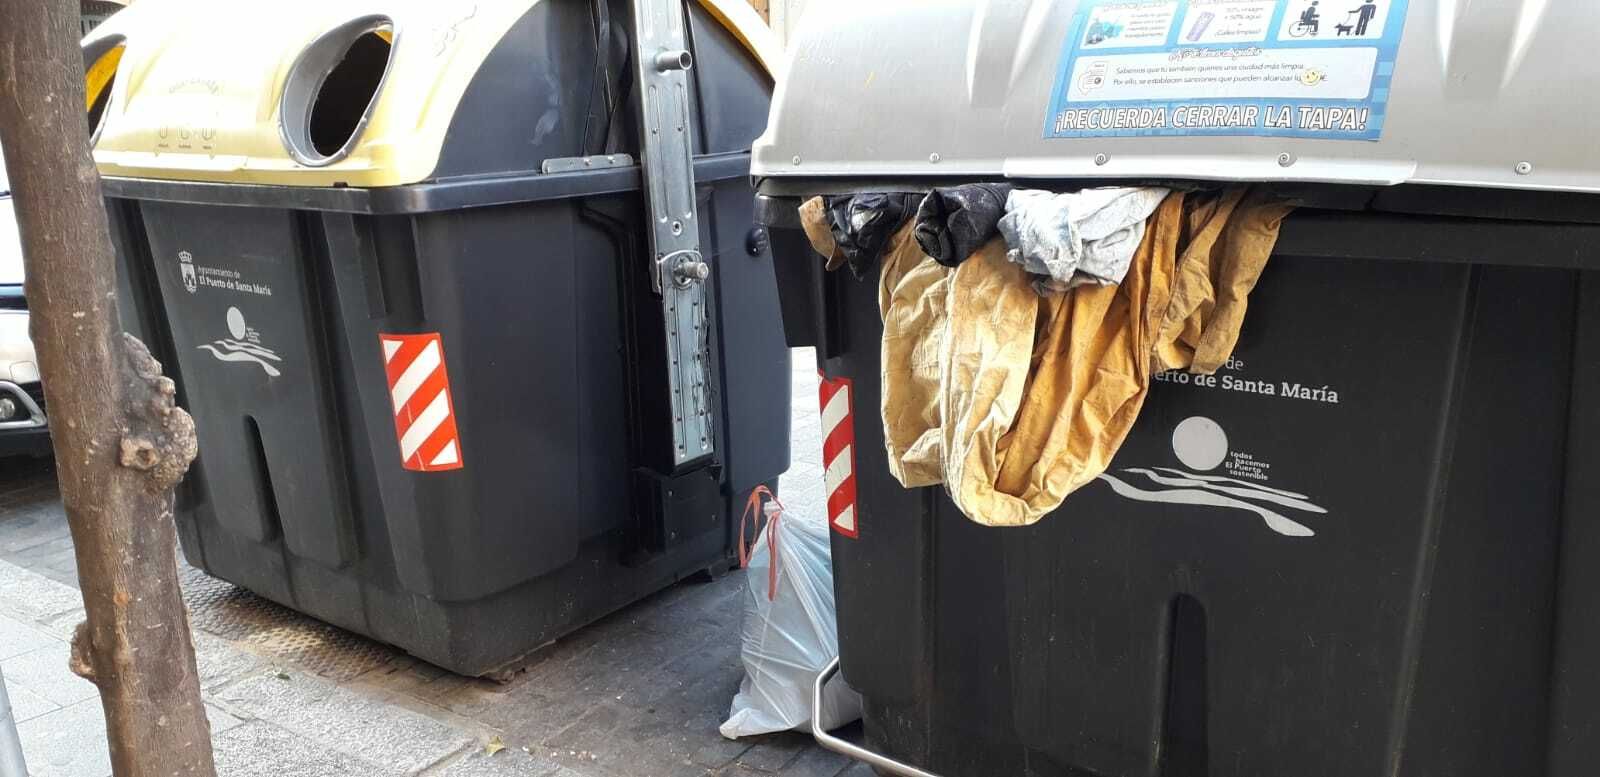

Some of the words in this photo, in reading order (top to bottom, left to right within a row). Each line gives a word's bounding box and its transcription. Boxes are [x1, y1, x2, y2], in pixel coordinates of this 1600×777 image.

[1055, 108, 1167, 134] ¡RECUERDA
[1171, 106, 1258, 128] CERRAR
[1263, 106, 1292, 129] LA
[1297, 106, 1369, 131] TAPA!
[199, 276, 206, 286] El
[206, 277, 226, 289] Puerto
[226, 279, 235, 290] de
[235, 281, 252, 293] Santa
[1225, 356, 1244, 371] de
[1194, 373, 1217, 388] de
[1222, 375, 1276, 395] Santa
[1281, 382, 1339, 403] María
[1230, 451, 1253, 460] todos
[1225, 461, 1233, 469] El
[1234, 461, 1262, 473] Puerto
[1235, 458, 1270, 469] hacemos
[1230, 469, 1268, 480] sostenible
